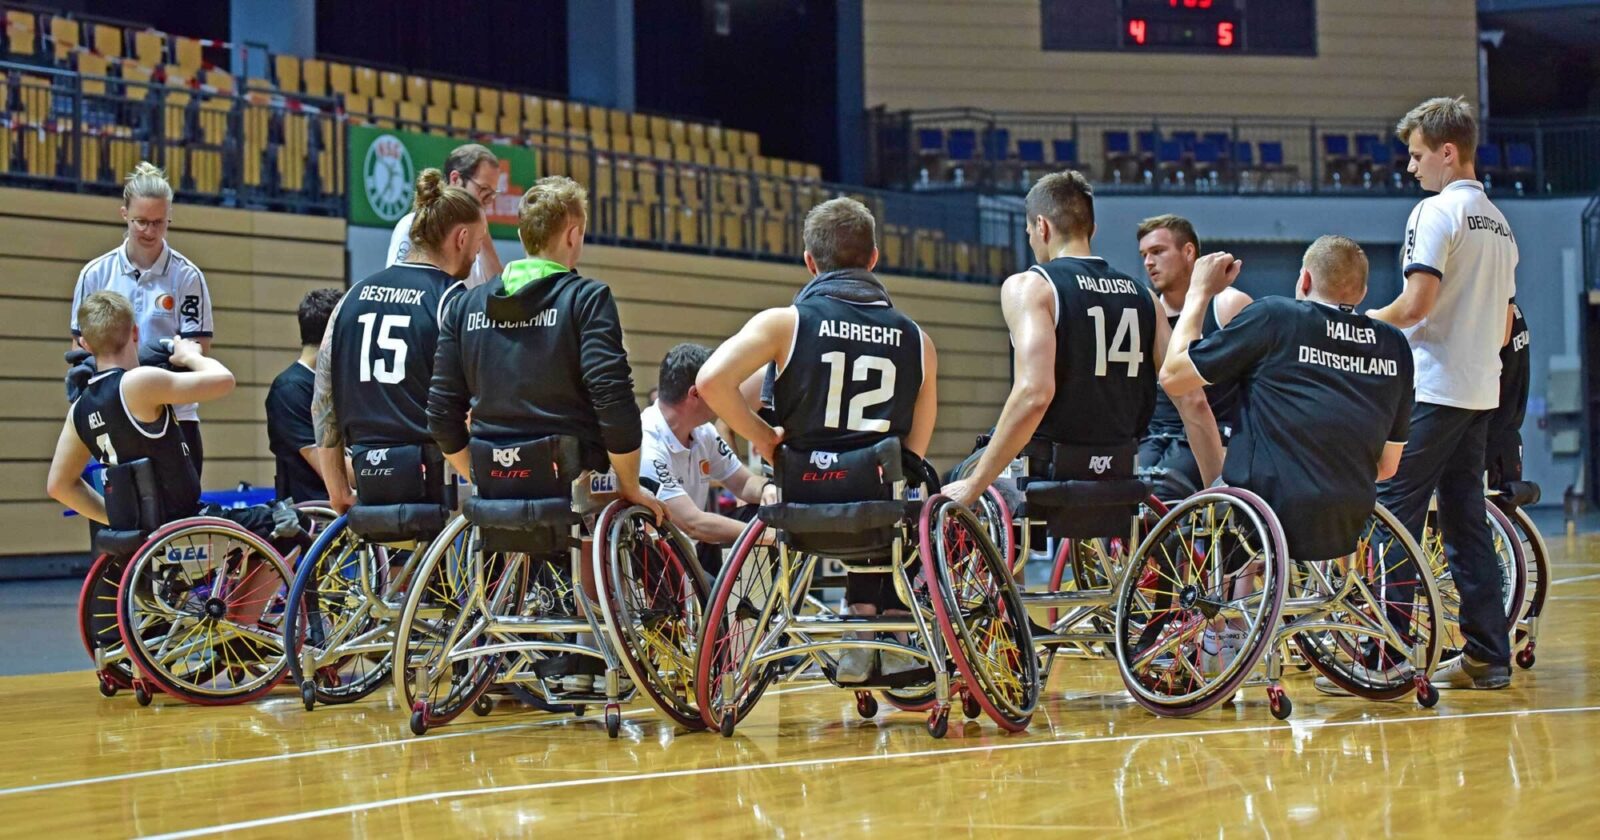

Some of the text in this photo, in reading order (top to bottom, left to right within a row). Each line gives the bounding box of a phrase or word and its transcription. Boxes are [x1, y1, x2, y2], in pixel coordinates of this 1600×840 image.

[1129, 20, 1146, 44] 4
[1217, 22, 1233, 46] 5
[359, 285, 425, 306] BESTWICK
[1076, 275, 1137, 295] HALOUSKI
[819, 320, 902, 347] ALBRECHT
[1087, 305, 1143, 377] 14
[1326, 320, 1376, 344] HALLER
[357, 313, 411, 384] 15
[1299, 345, 1398, 376] DEUTSCHLAND
[821, 351, 896, 432] 12
[361, 468, 394, 476] ELITE
[491, 470, 531, 478] ELITE
[591, 475, 613, 492] GEL
[802, 470, 848, 481] ELITE
[168, 547, 207, 562] GEL
